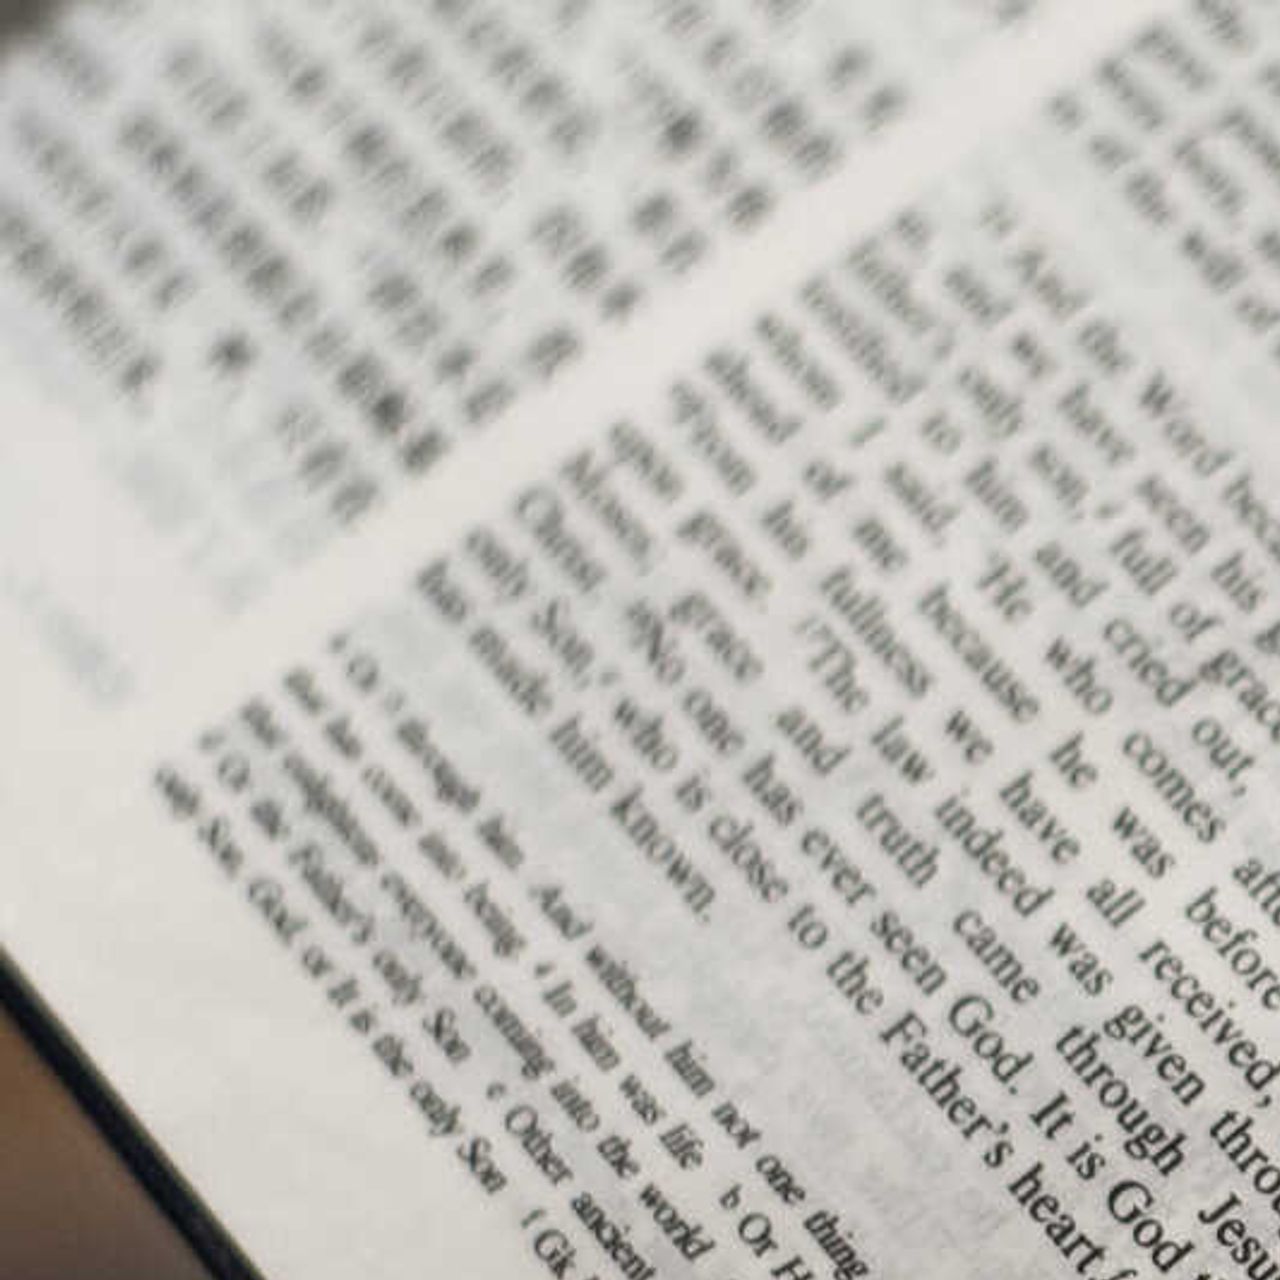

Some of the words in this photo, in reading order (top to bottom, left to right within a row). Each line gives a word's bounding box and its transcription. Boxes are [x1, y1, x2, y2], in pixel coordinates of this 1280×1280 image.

[1030, 540, 1109, 610] and
[1101, 617, 1202, 708] cried
[1189, 717, 1256, 799] out,
[1106, 527, 1179, 598] full
[1166, 601, 1224, 646] of
[1208, 549, 1267, 615] his
[915, 582, 1041, 724] because
[1046, 730, 1099, 789] he
[1111, 805, 1176, 879] was
[943, 709, 994, 764] we
[997, 768, 1081, 865] have
[1084, 877, 1146, 930] all
[1043, 635, 1114, 716] who
[1120, 731, 1227, 844] comes
[607, 784, 716, 923] known.
[611, 696, 678, 771] who
[673, 772, 712, 814] is
[705, 814, 790, 904] close
[785, 902, 829, 951] to
[824, 948, 884, 1016] the
[773, 707, 852, 779] and
[854, 792, 941, 890] truth
[951, 908, 1041, 1005] came
[1054, 1024, 1188, 1178] through
[868, 714, 934, 785] law
[932, 794, 1055, 919] indeed
[1047, 921, 1114, 997] was
[1101, 1004, 1206, 1108] given
[739, 751, 804, 828] has
[798, 826, 877, 908] ever
[868, 909, 947, 997] seen
[946, 992, 1035, 1096] God.
[1028, 1090, 1075, 1141] It
[1064, 1133, 1106, 1181] is
[1105, 1178, 1196, 1275] God
[502, 1103, 574, 1187] Other
[618, 1072, 667, 1126] was
[736, 1211, 779, 1258] Or
[710, 1099, 762, 1150] not
[754, 1154, 806, 1206] one
